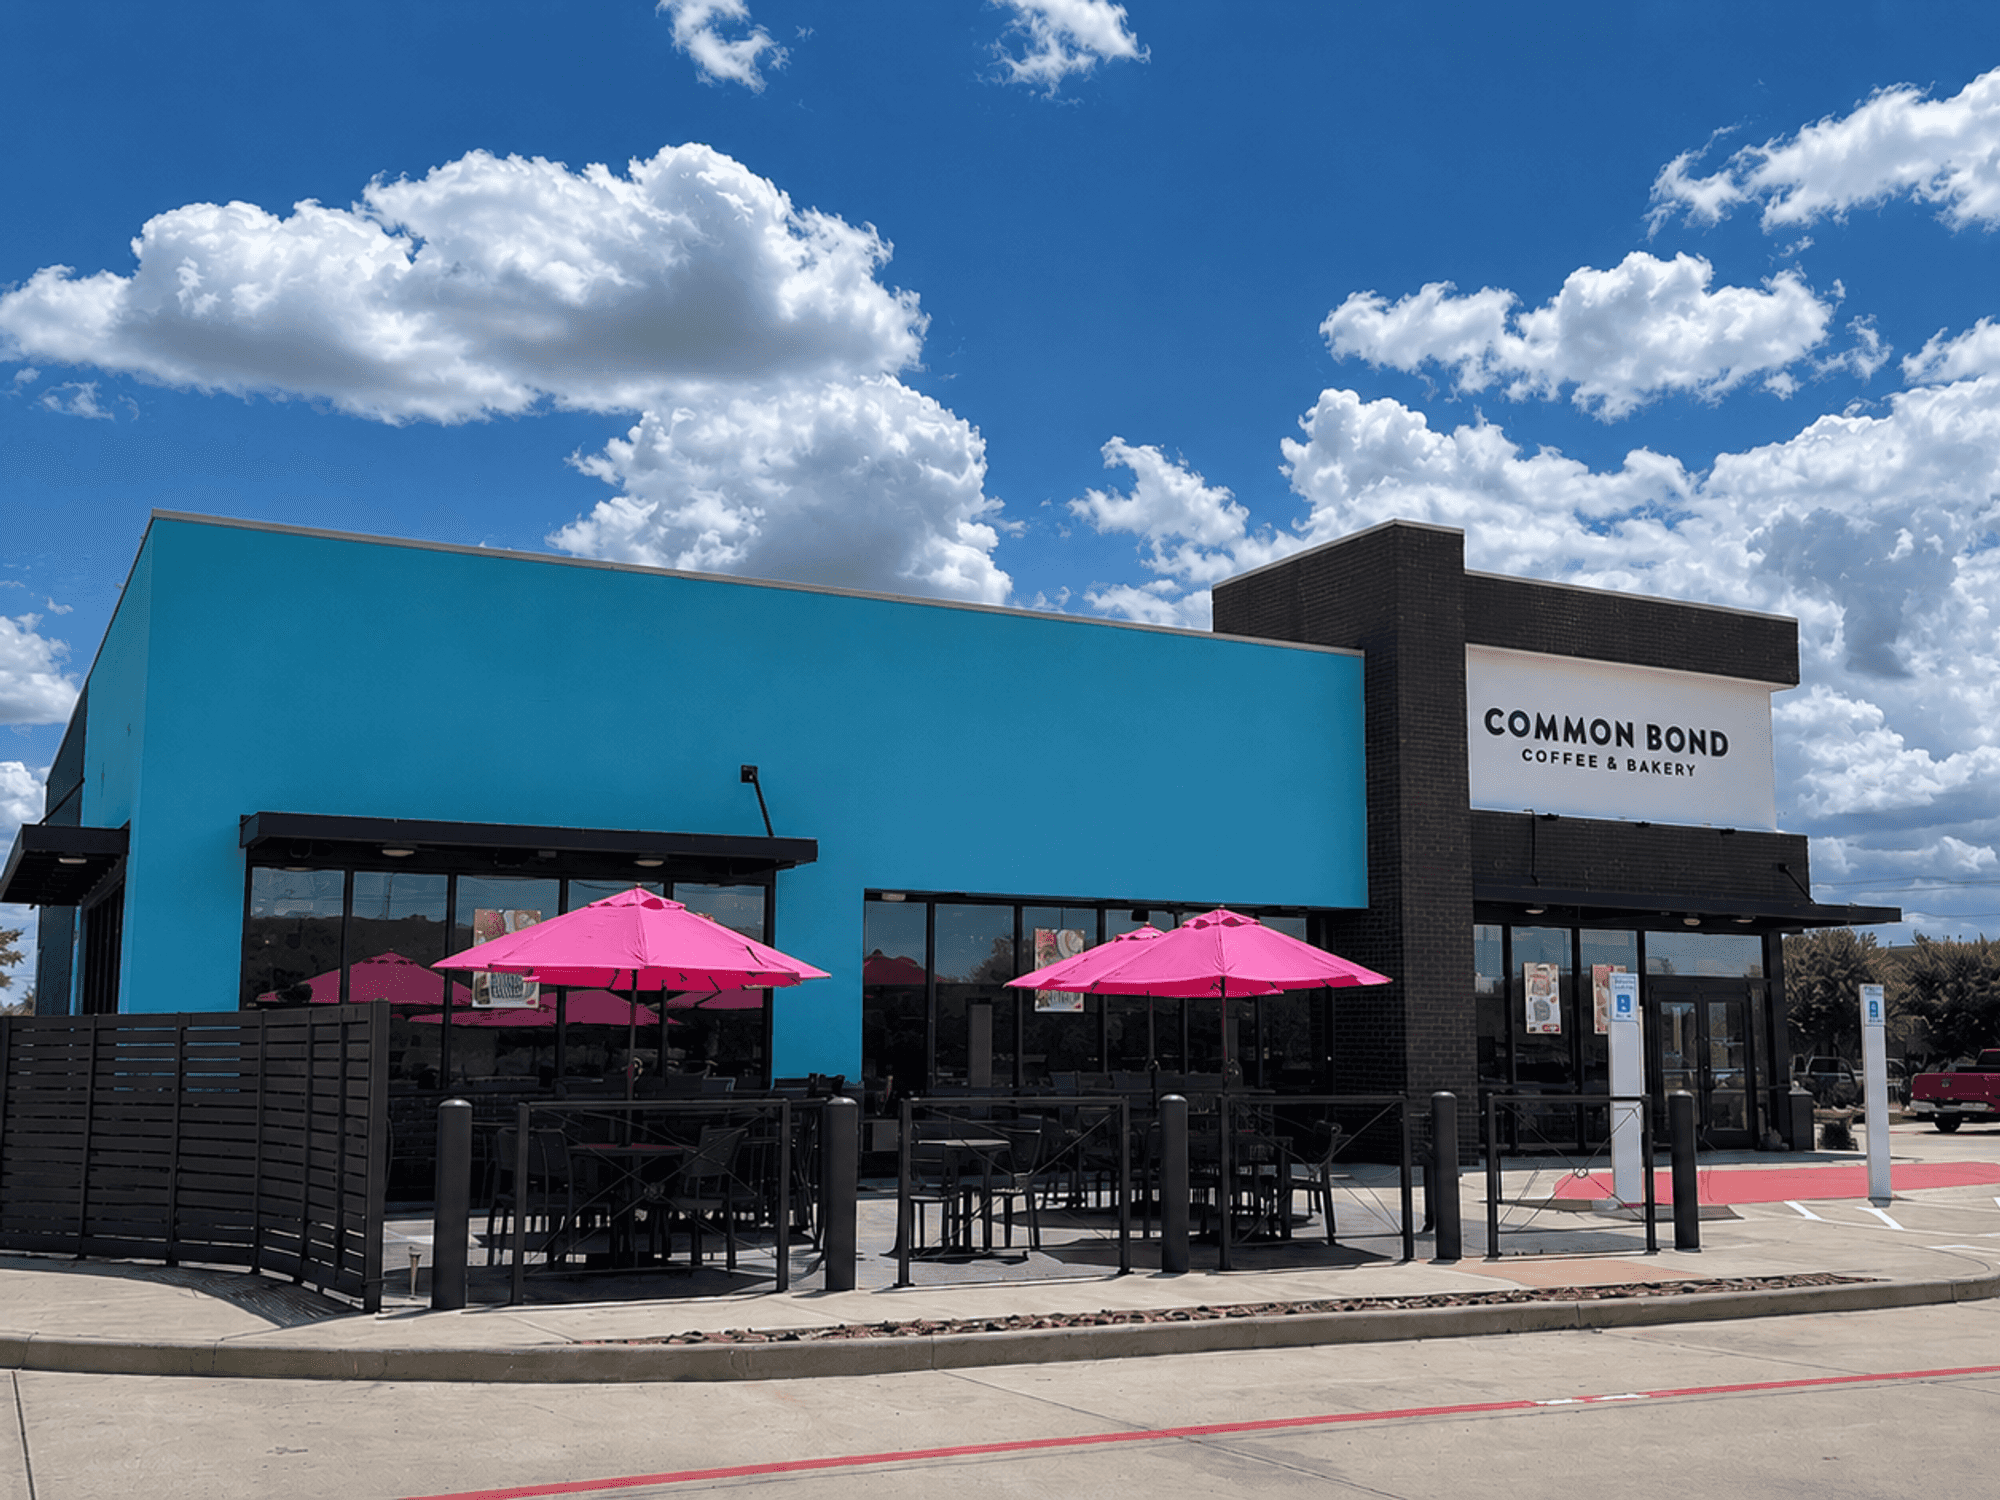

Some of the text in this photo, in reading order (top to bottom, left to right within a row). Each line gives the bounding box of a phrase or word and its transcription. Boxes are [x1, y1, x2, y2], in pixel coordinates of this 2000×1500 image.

[1484, 707, 1729, 757] COMMON BOND
[1521, 748, 1696, 777] COFFEE & BAKERY
